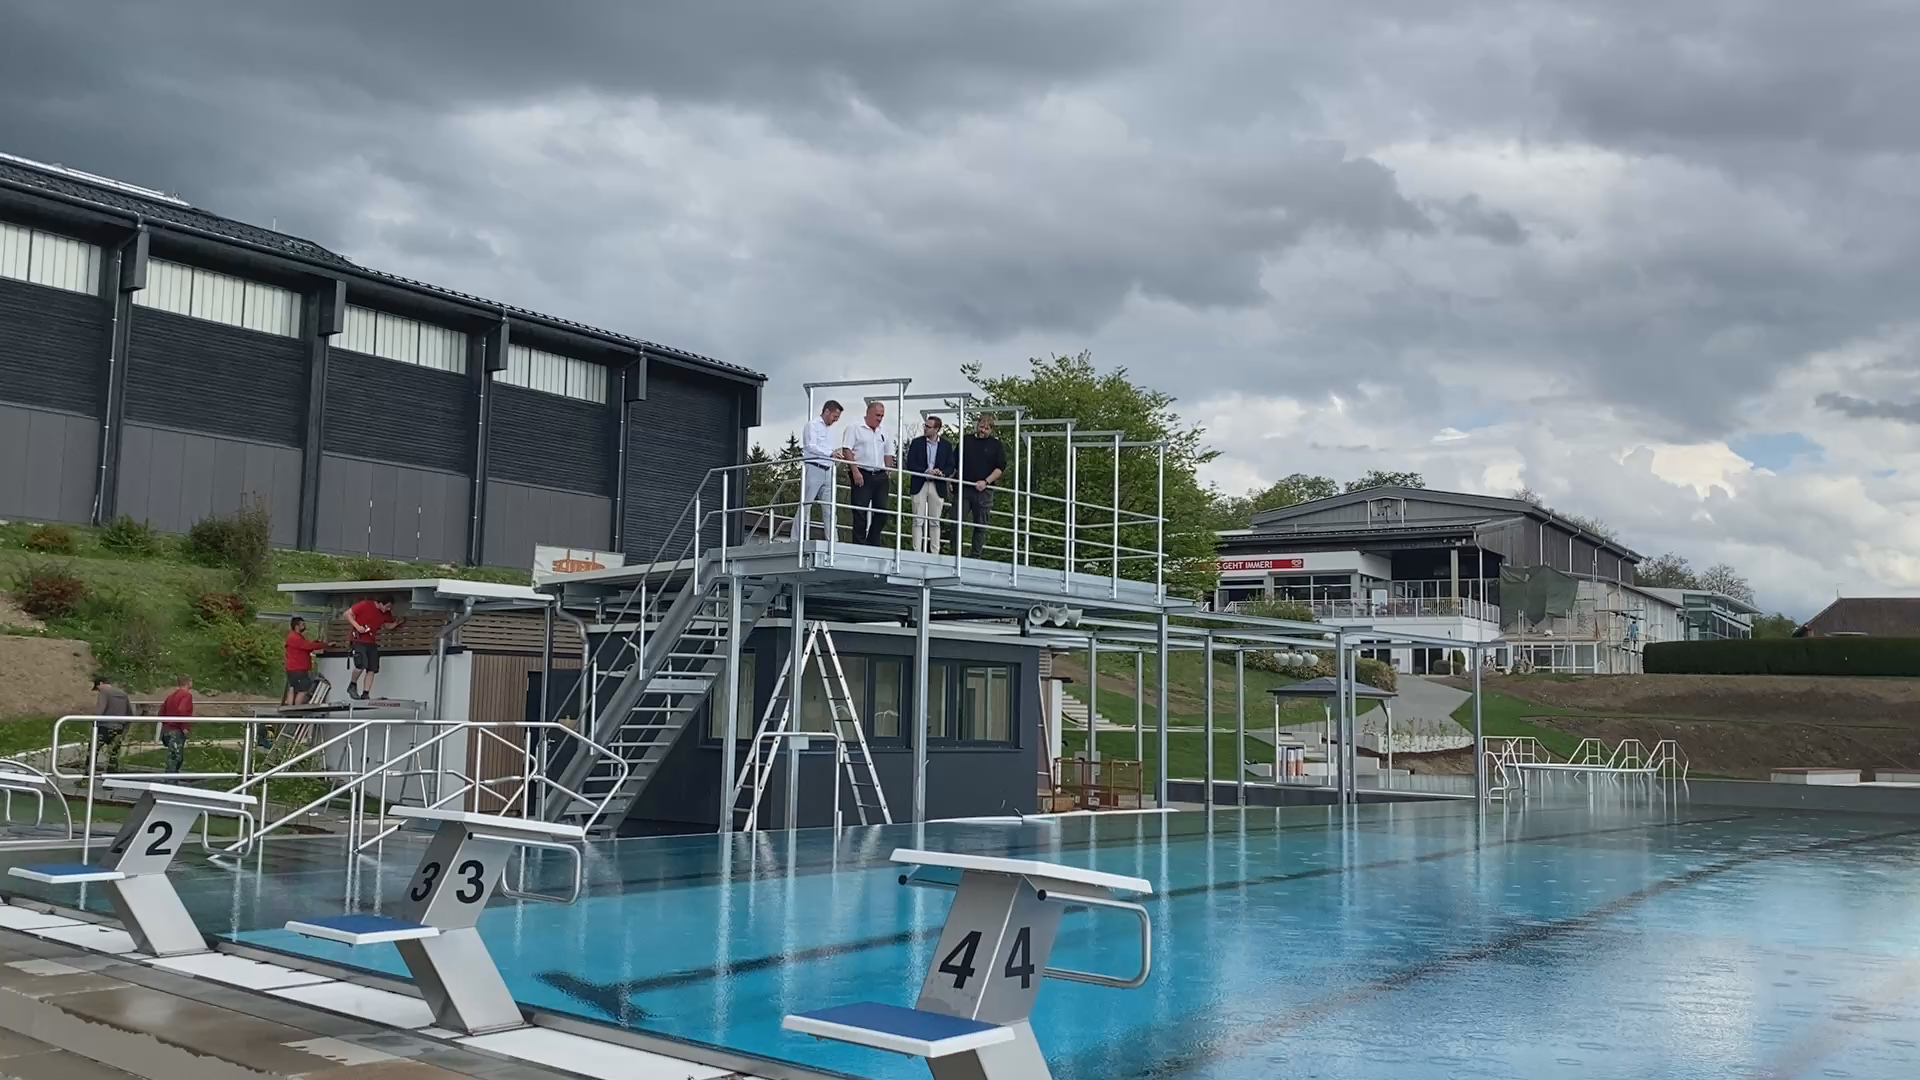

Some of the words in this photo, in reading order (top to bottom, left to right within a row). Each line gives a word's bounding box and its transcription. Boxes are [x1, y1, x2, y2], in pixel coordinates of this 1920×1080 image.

[1222, 561, 1244, 570] GEHT
[1245, 560, 1273, 569] IMMER!
[145, 821, 173, 856] 2
[410, 862, 441, 902] 3
[456, 860, 485, 904] 3
[938, 930, 983, 989] 4
[1004, 926, 1035, 989] 4
